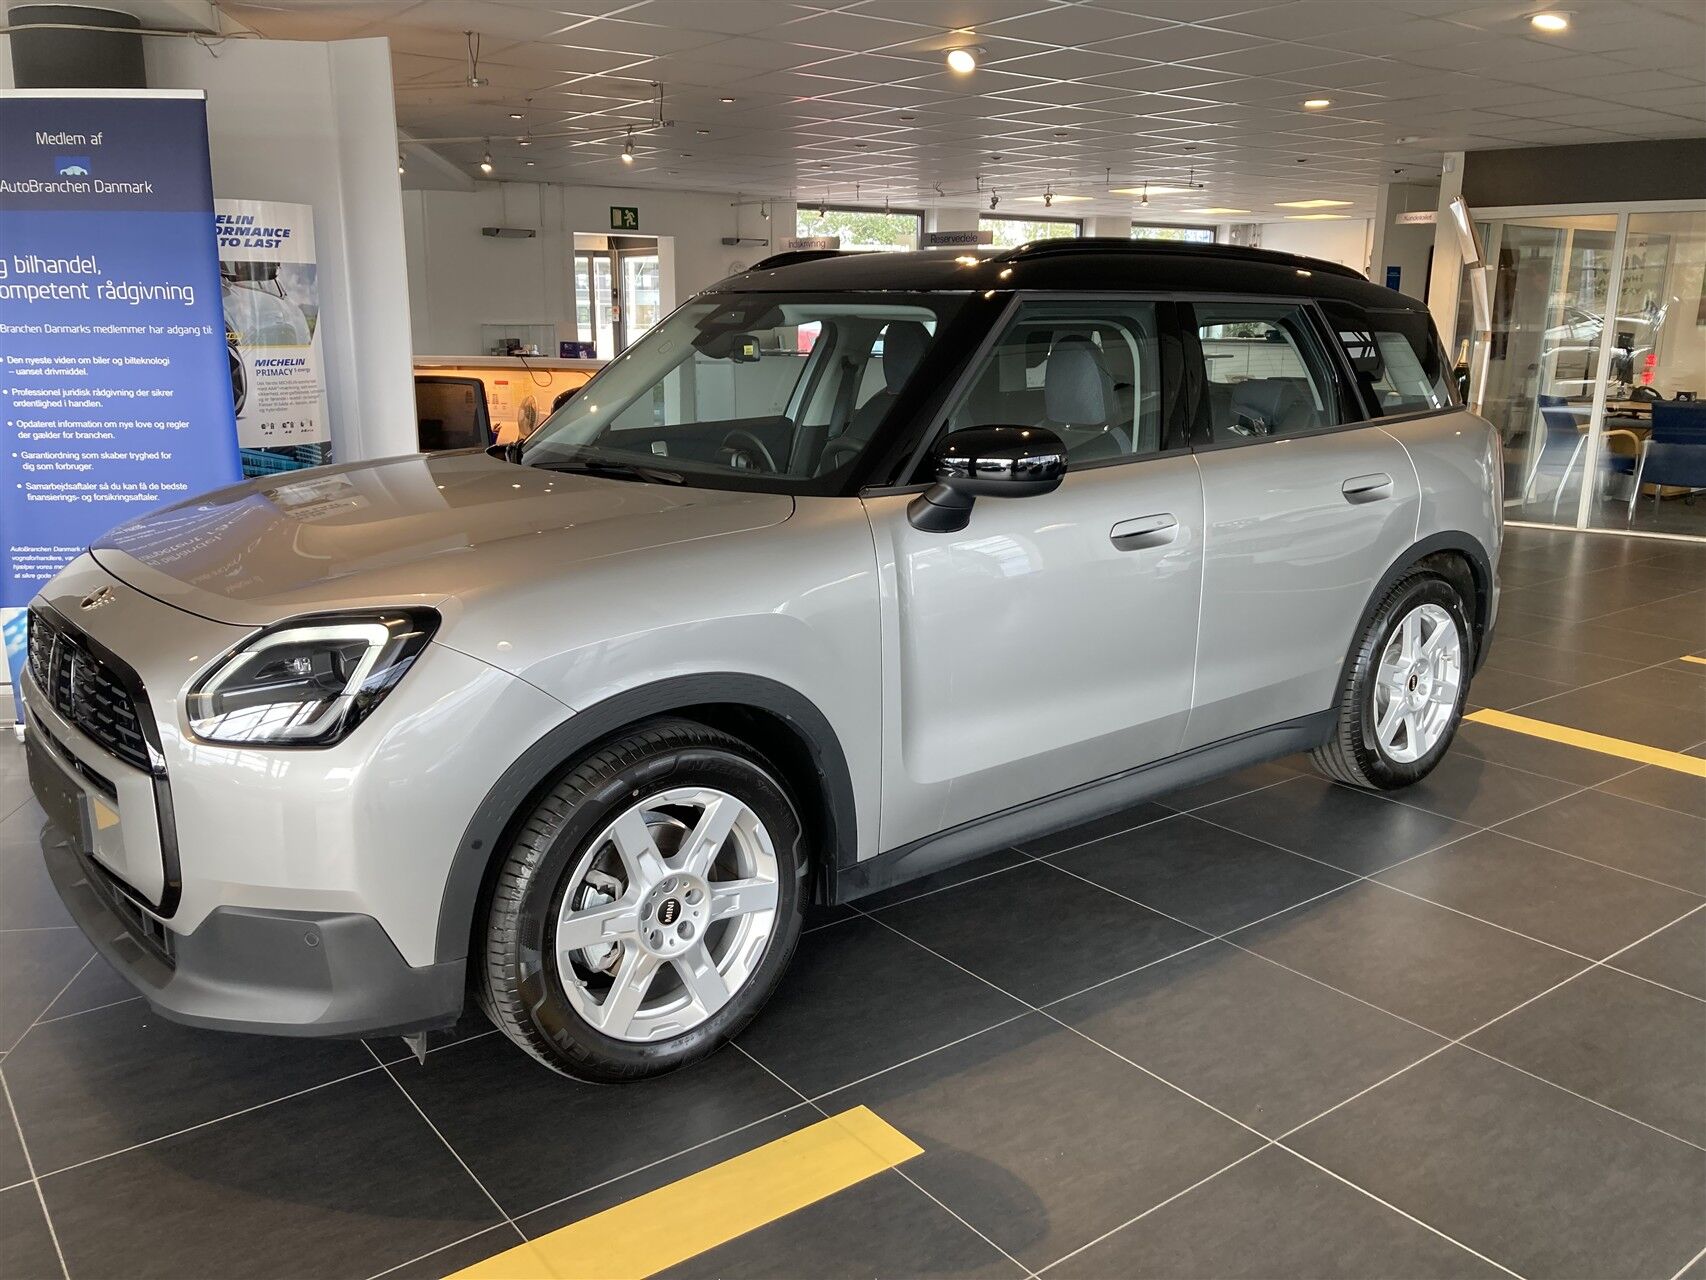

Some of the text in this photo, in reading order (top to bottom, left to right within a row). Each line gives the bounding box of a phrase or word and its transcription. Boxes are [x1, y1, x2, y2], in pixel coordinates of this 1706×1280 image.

[35, 132, 103, 145] Medlem af
[0, 180, 153, 194] AutoBranchen Danmark
[220, 238, 282, 248] TO LAST
[930, 232, 978, 244] Reservedele
[14, 254, 102, 275] bilhandel,
[97, 280, 194, 306] rådgivning
[44, 323, 91, 334] Danmarks
[93, 325, 146, 334] medlemmer
[149, 325, 164, 334] har
[167, 325, 201, 336] adgang
[7, 356, 24, 364] Den
[25, 357, 52, 365] nyeste
[54, 356, 77, 364] viden
[124, 357, 170, 366] bilteknologi
[255, 359, 306, 367] MICHELIN
[256, 368, 293, 376] PRIMACY
[12, 388, 174, 398] Professionel juridisk rådgivning der sikrer
[13, 400, 62, 409] ordentlighed
[68, 400, 103, 408] handlen.
[16, 420, 56, 429] Opdateret
[58, 420, 102, 428] information
[119, 422, 134, 430] nye
[135, 420, 152, 428] love
[154, 422, 165, 430] og
[166, 421, 190, 430] regler
[18, 431, 115, 440] der gælder for branchen.
[21, 451, 80, 460] Garantiordning
[101, 451, 127, 459] skaber
[129, 452, 159, 461] tryghed
[22, 463, 35, 471] dig
[55, 463, 94, 471] forbruger.
[26, 482, 98, 491] Samarbejdsaftaler
[99, 482, 109, 490] så
[139, 482, 147, 490] få
[94, 493, 160, 502] forsikringsaftaler.
[664, 901, 675, 923] MINI
